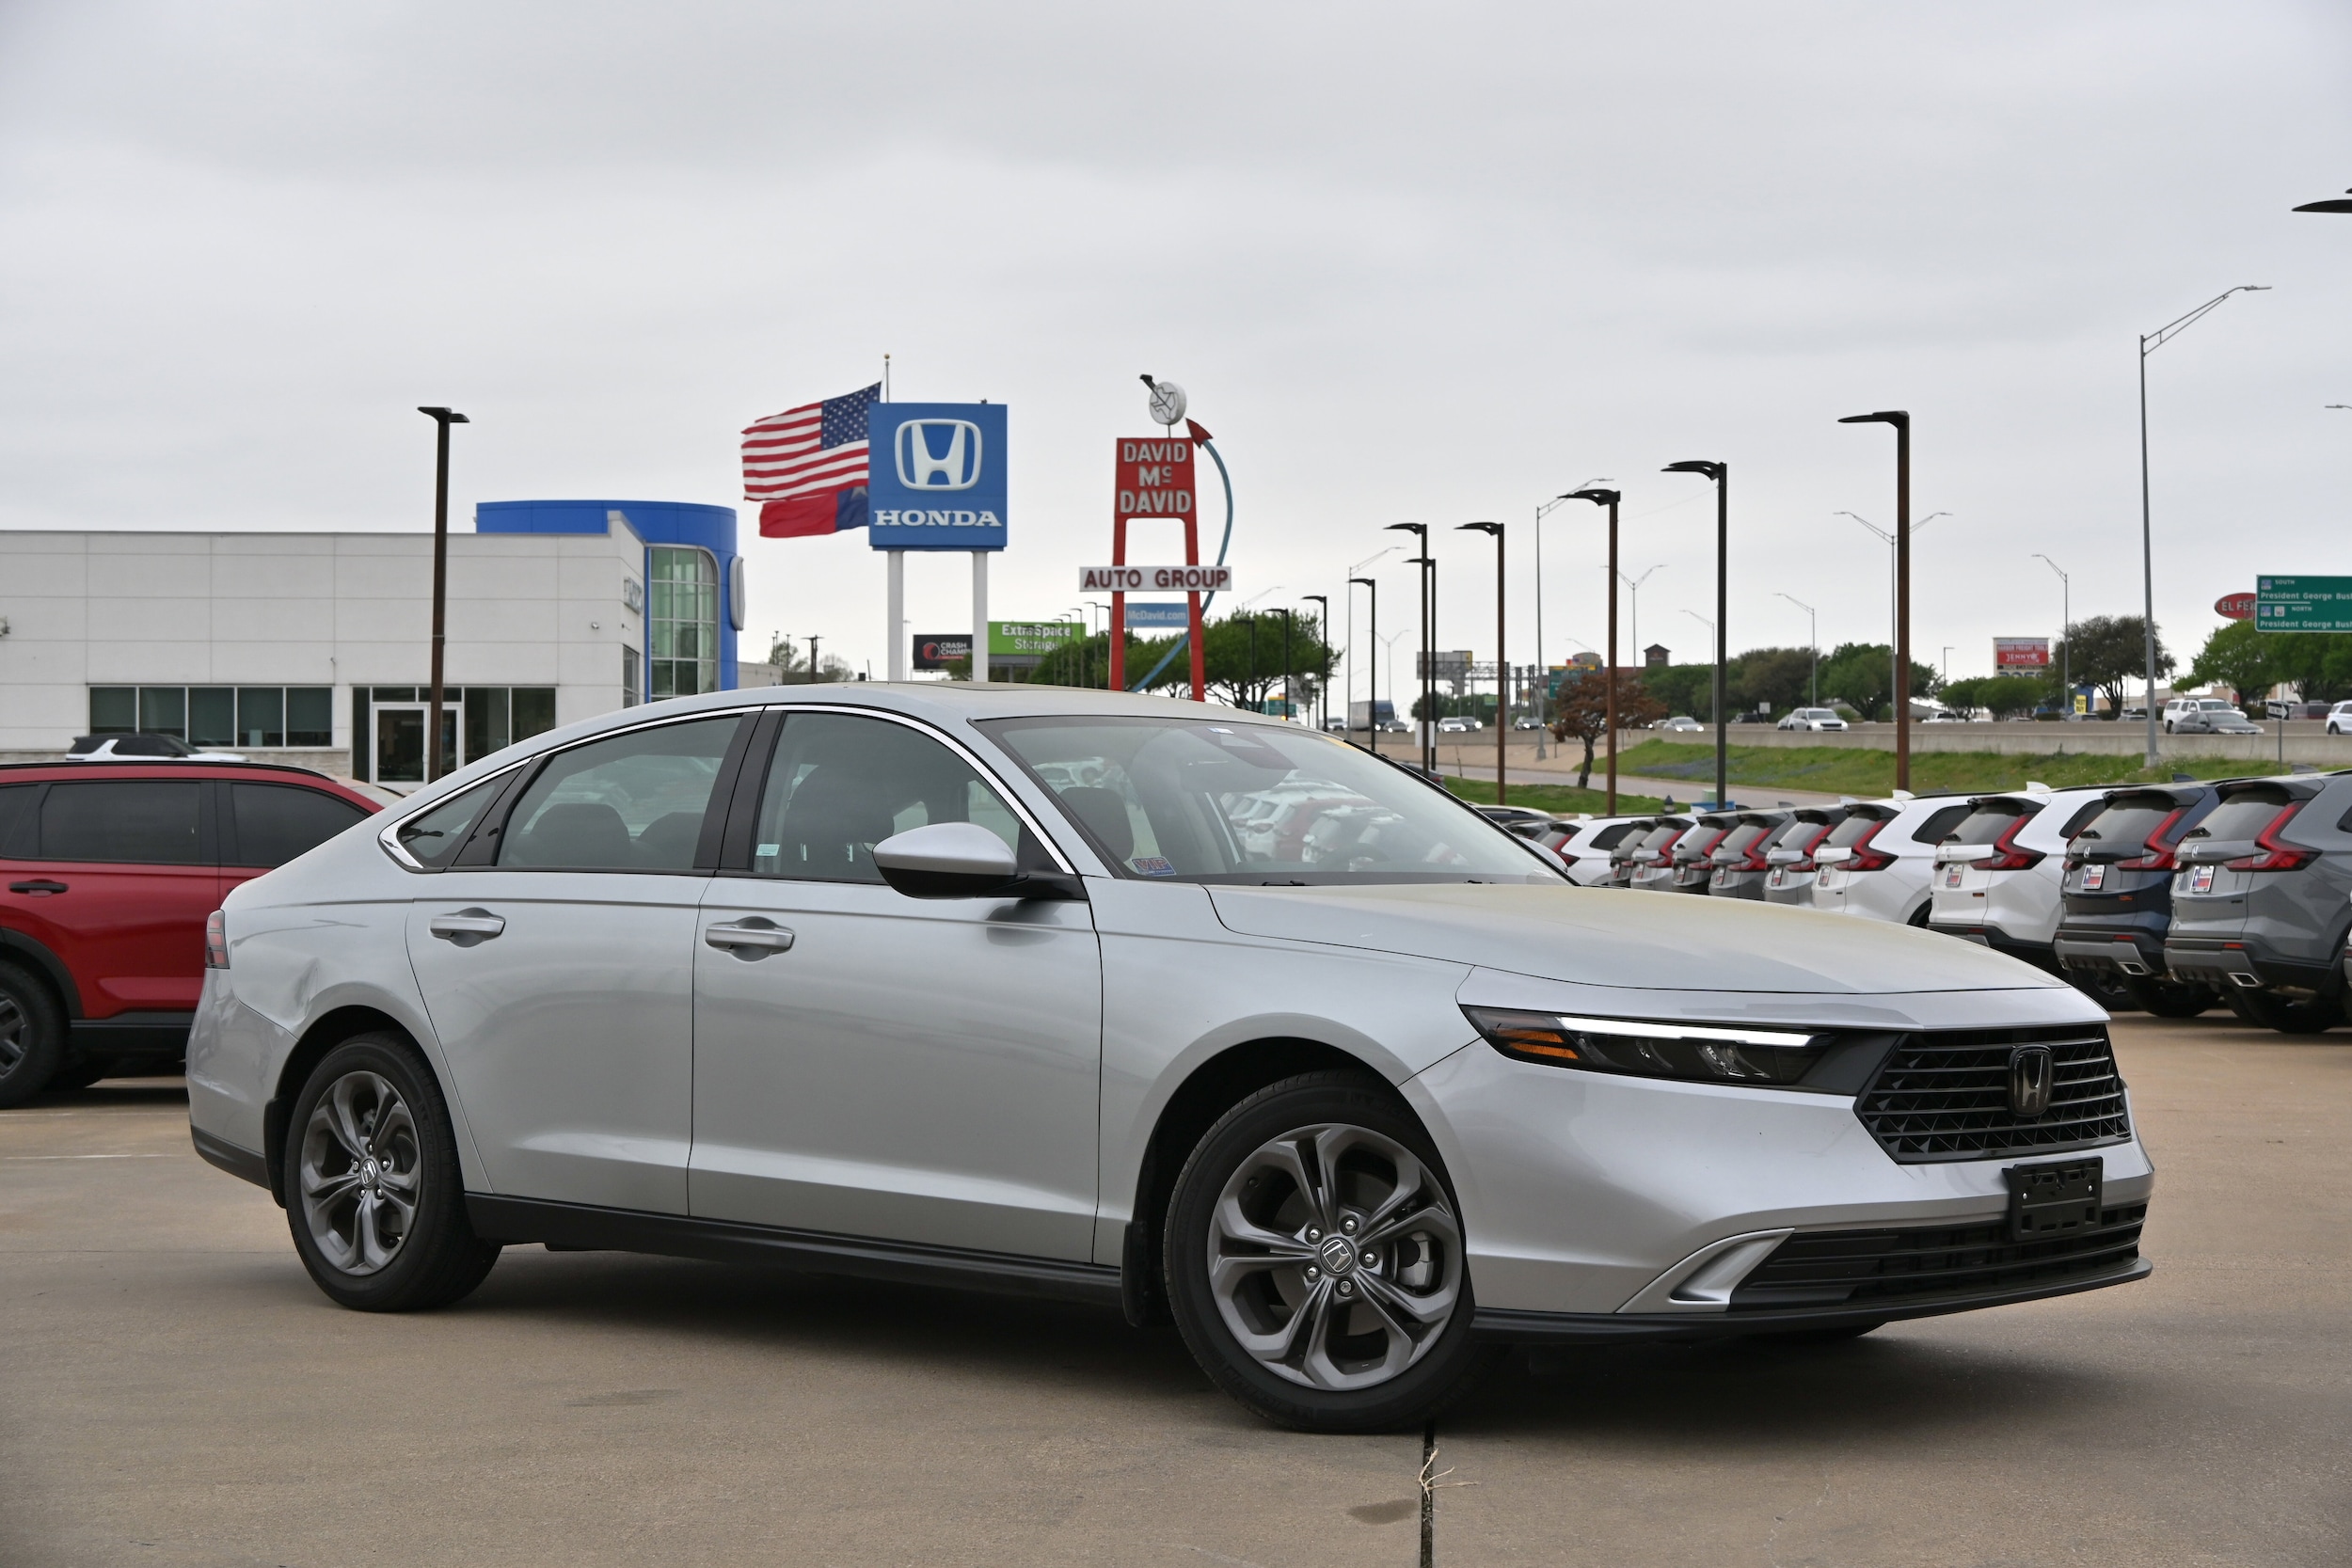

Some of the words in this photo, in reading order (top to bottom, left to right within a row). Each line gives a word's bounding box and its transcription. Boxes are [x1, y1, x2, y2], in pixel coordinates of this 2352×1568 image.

[1124, 443, 1187, 462] DAVID
[1138, 466, 1172, 487] Mc
[1120, 490, 1192, 513] DAVID
[874, 510, 1002, 527] HONDA
[1084, 570, 1142, 588] AUTO
[1154, 569, 1229, 588] GROUP
[2303, 593, 2332, 601] George
[2221, 601, 2234, 611] EL
[1127, 610, 1186, 621] McDavid.com
[2302, 621, 2331, 629] George
[1014, 638, 1058, 652] Storage
[1133, 858, 1168, 871] VIP
